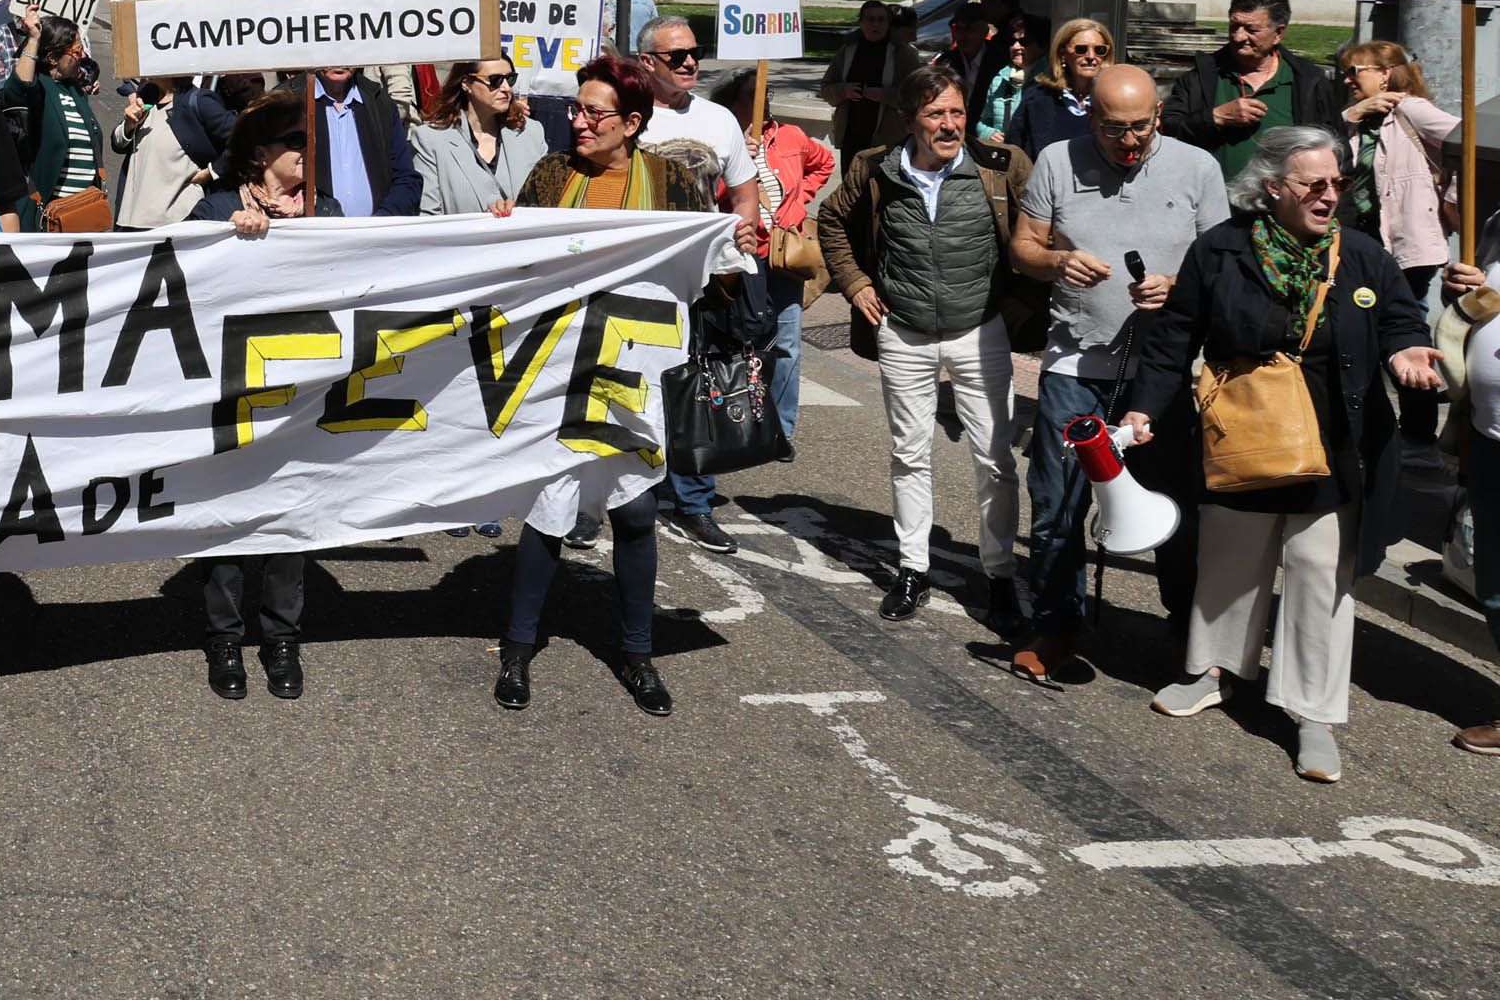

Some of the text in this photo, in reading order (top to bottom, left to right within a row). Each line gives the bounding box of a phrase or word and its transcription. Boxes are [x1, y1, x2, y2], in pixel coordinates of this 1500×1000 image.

[150, 7, 476, 51] CAMPOHERMOSO
[549, 3, 577, 26] DE
[212, 290, 683, 469] FEVE
[81, 466, 177, 536] DE
